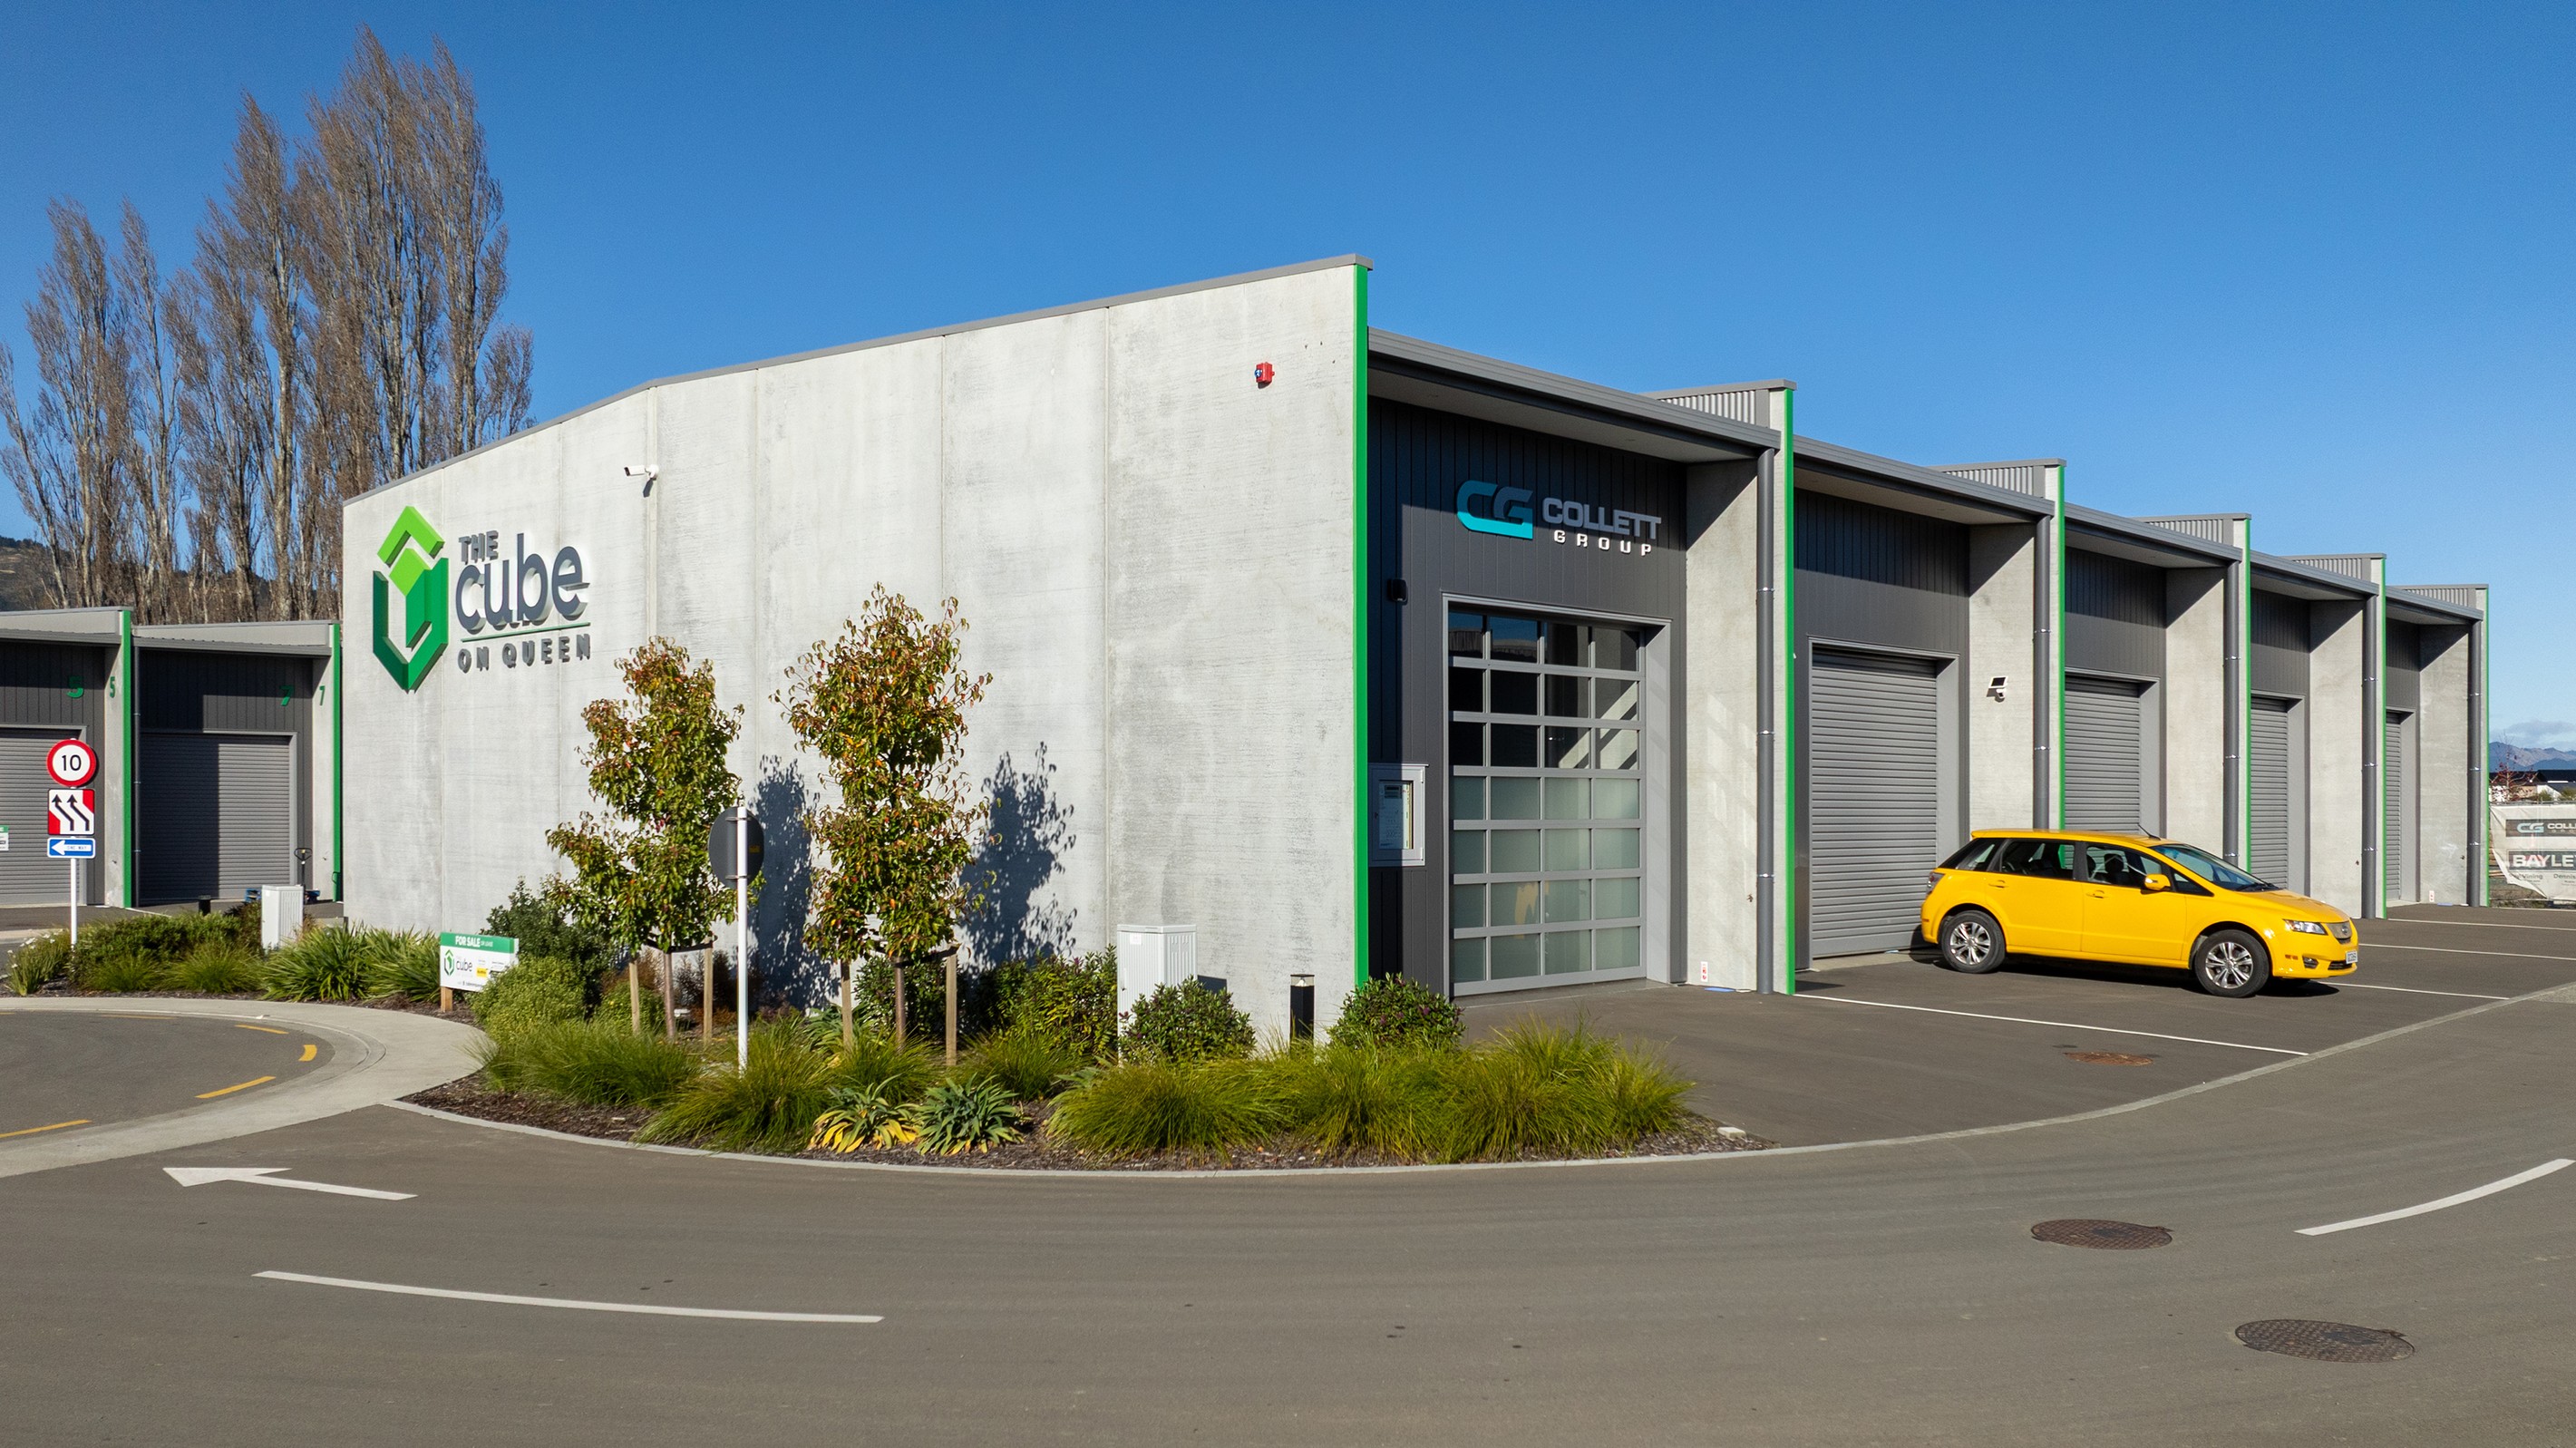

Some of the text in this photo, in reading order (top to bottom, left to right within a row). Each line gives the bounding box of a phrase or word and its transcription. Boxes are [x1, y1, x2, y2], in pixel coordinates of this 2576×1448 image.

[1457, 480, 1533, 539] CG
[1542, 497, 1662, 539] COLLETT
[458, 530, 499, 565] THE
[1554, 530, 1652, 557] GROUP
[455, 533, 589, 634] cube
[458, 634, 590, 673] ON QUEEN
[66, 675, 84, 699] 5
[110, 676, 116, 698] 5
[62, 754, 82, 771] 10
[2517, 822, 2544, 833] CG
[2513, 854, 2576, 868] BAYLE
[455, 935, 466, 946] FOR
[466, 937, 481, 948] SALE
[456, 958, 472, 972] cube
